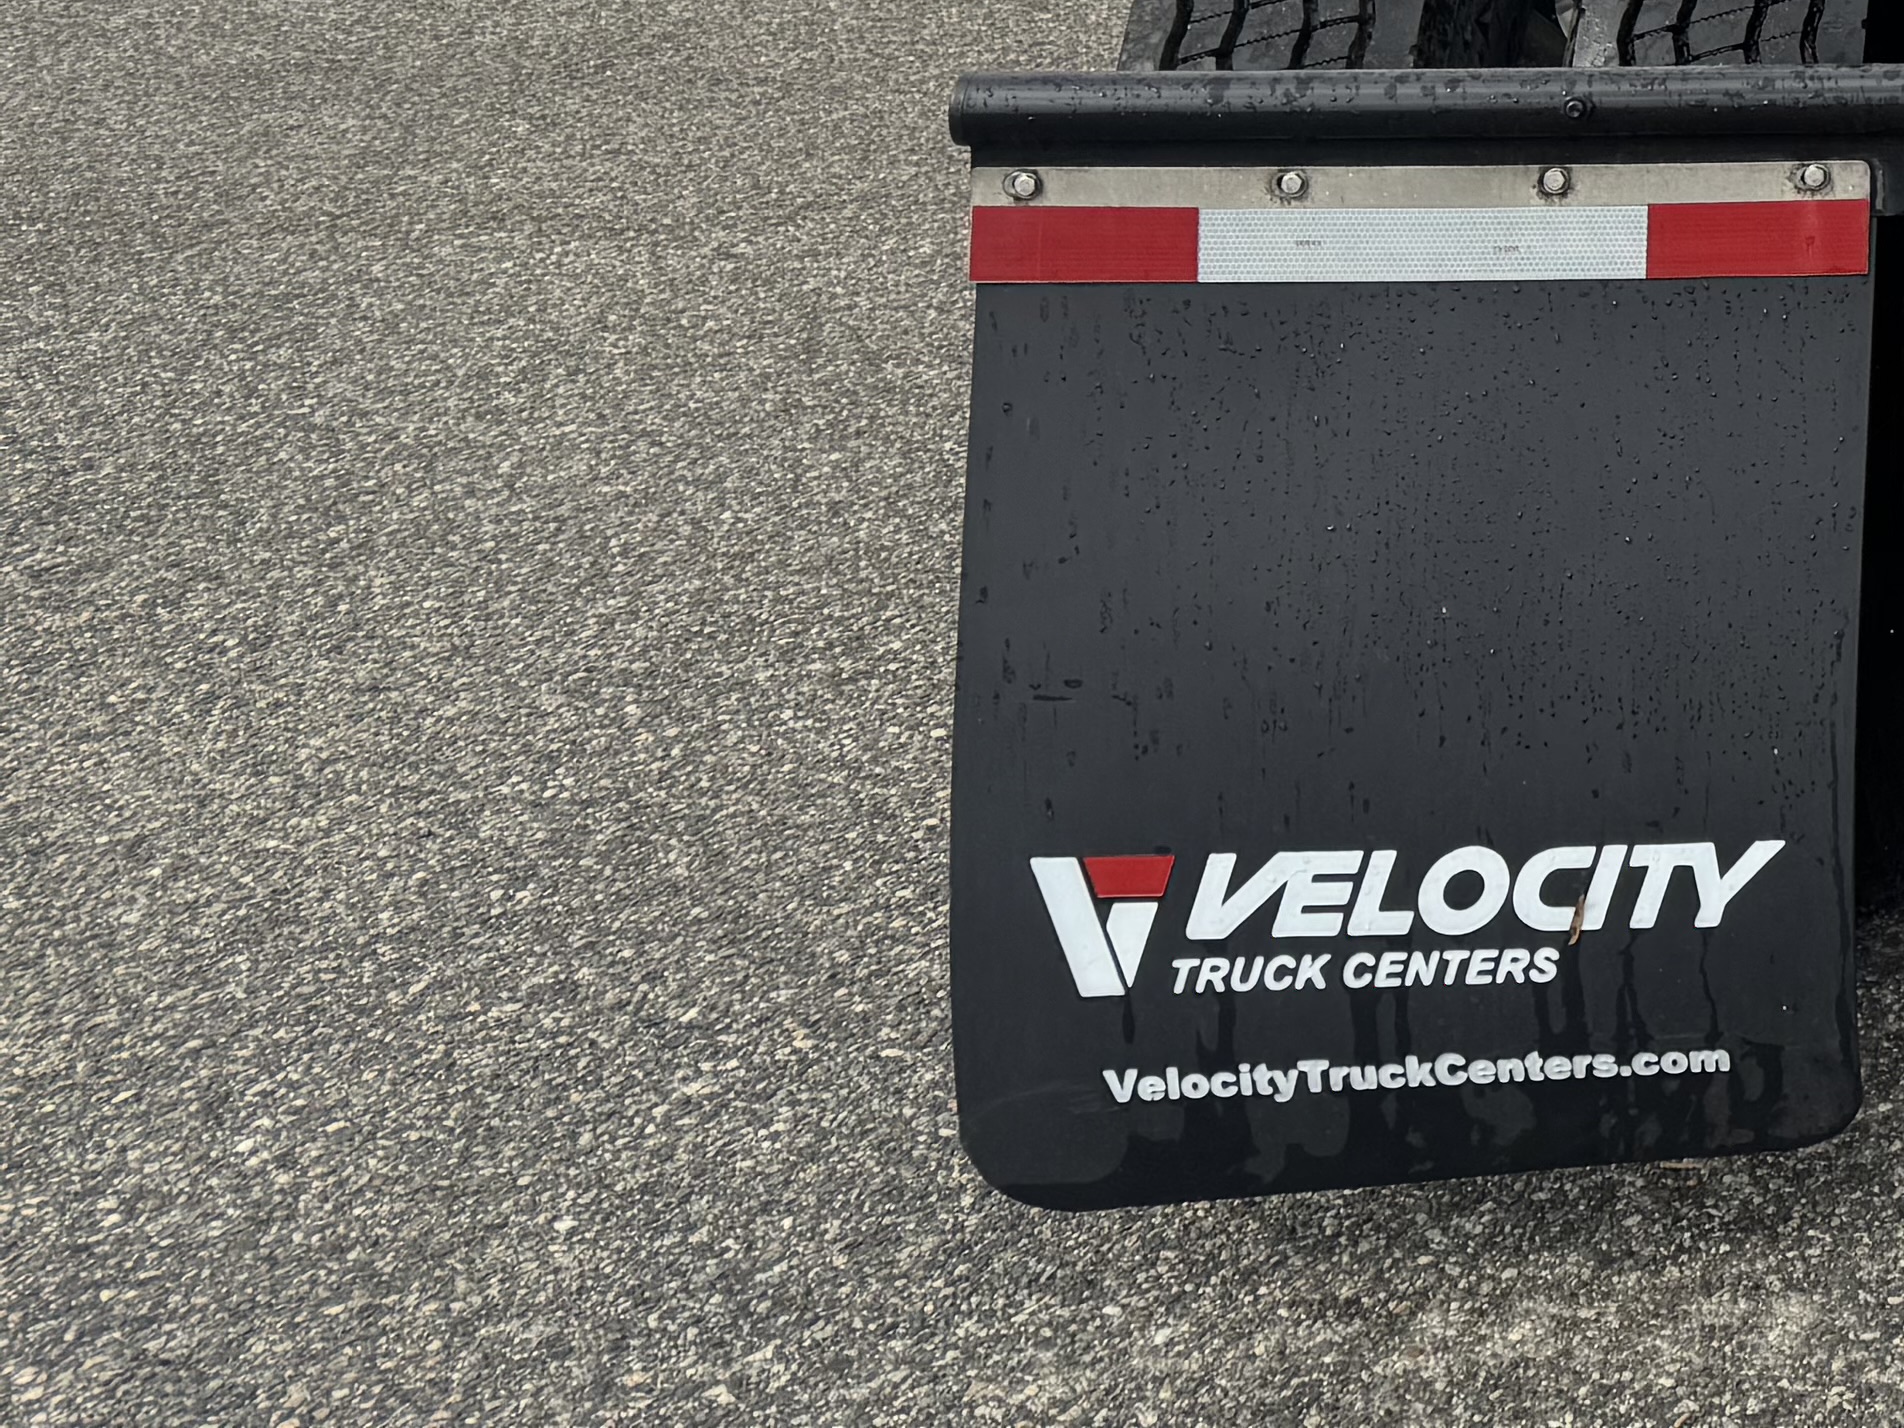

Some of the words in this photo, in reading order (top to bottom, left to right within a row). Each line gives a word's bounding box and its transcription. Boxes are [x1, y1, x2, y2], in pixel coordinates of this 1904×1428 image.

[1185, 839, 1786, 940] VELOCITY
[1171, 953, 1328, 995] TRUCK
[1342, 947, 1560, 989] CENTERS
[1102, 1049, 1731, 1104] VelocityTruckCenters.com
